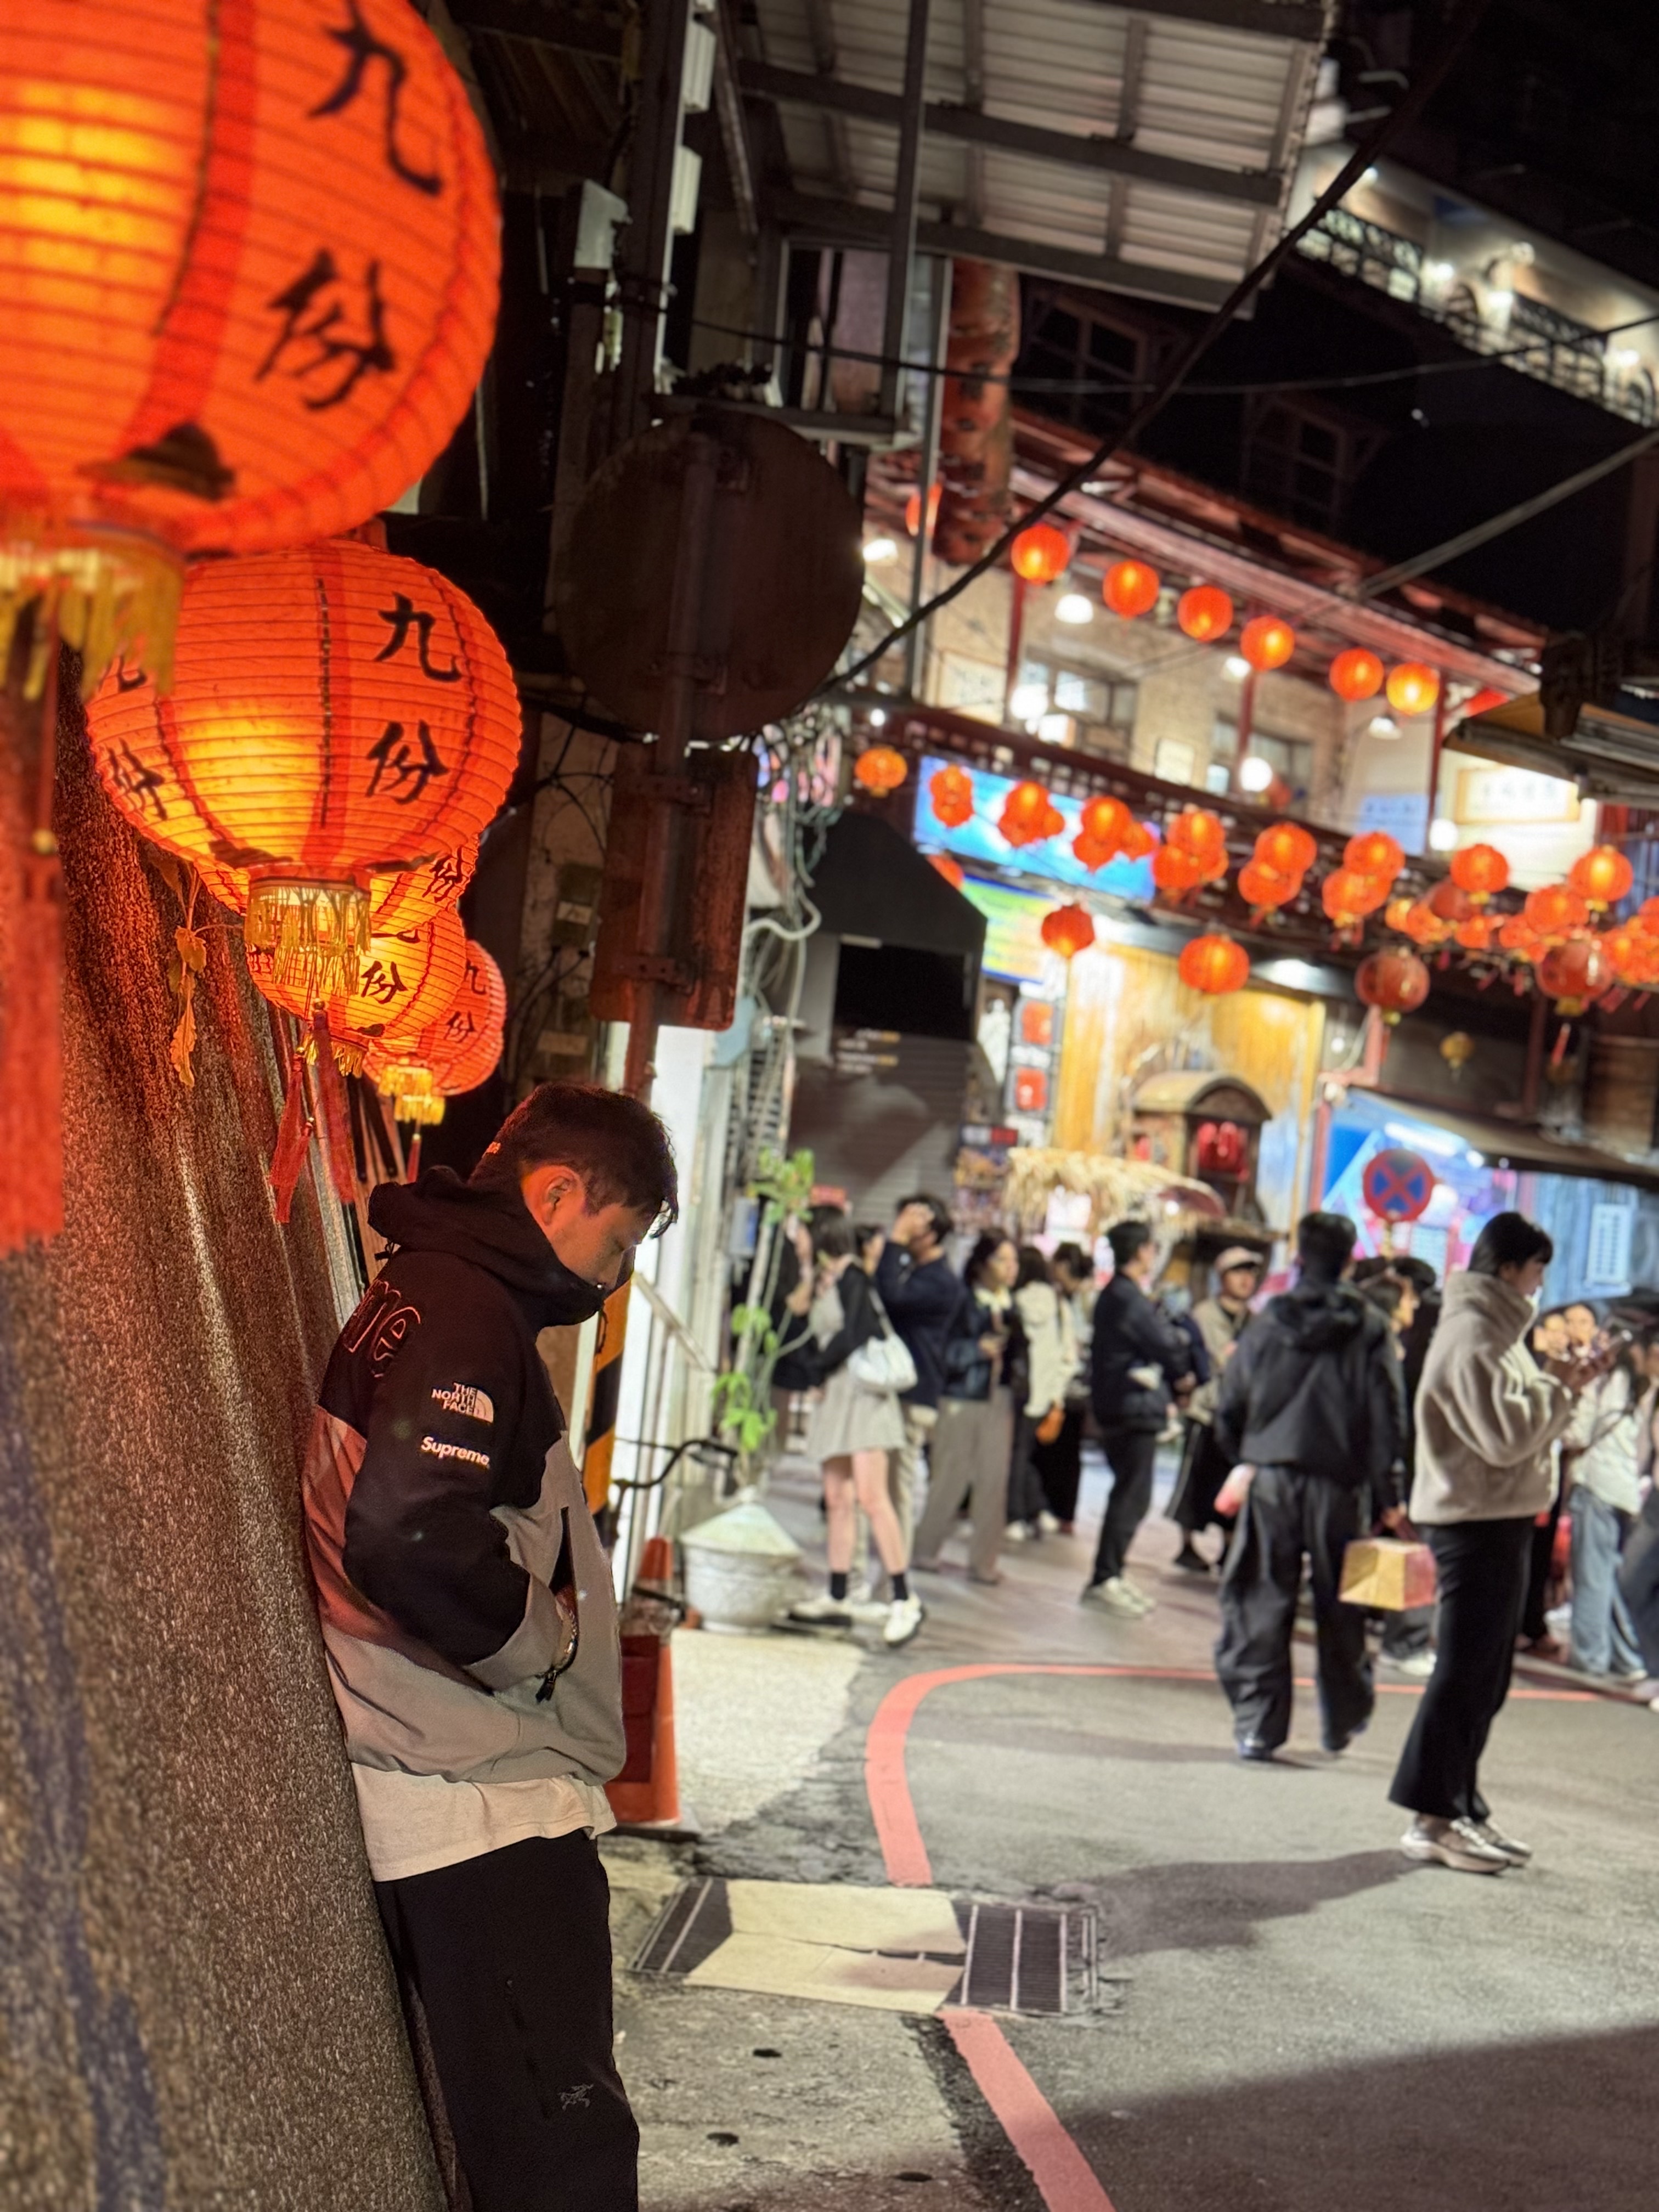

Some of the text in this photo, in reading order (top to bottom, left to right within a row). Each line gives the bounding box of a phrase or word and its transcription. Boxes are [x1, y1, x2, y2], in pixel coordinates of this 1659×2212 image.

[252, 0, 445, 410] 九份
[365, 591, 462, 805] 九份
[431, 1389, 476, 1408] NORTH
[453, 1383, 477, 1396] THE
[443, 1400, 474, 1416] FACE
[421, 1436, 490, 1465] Supreme
